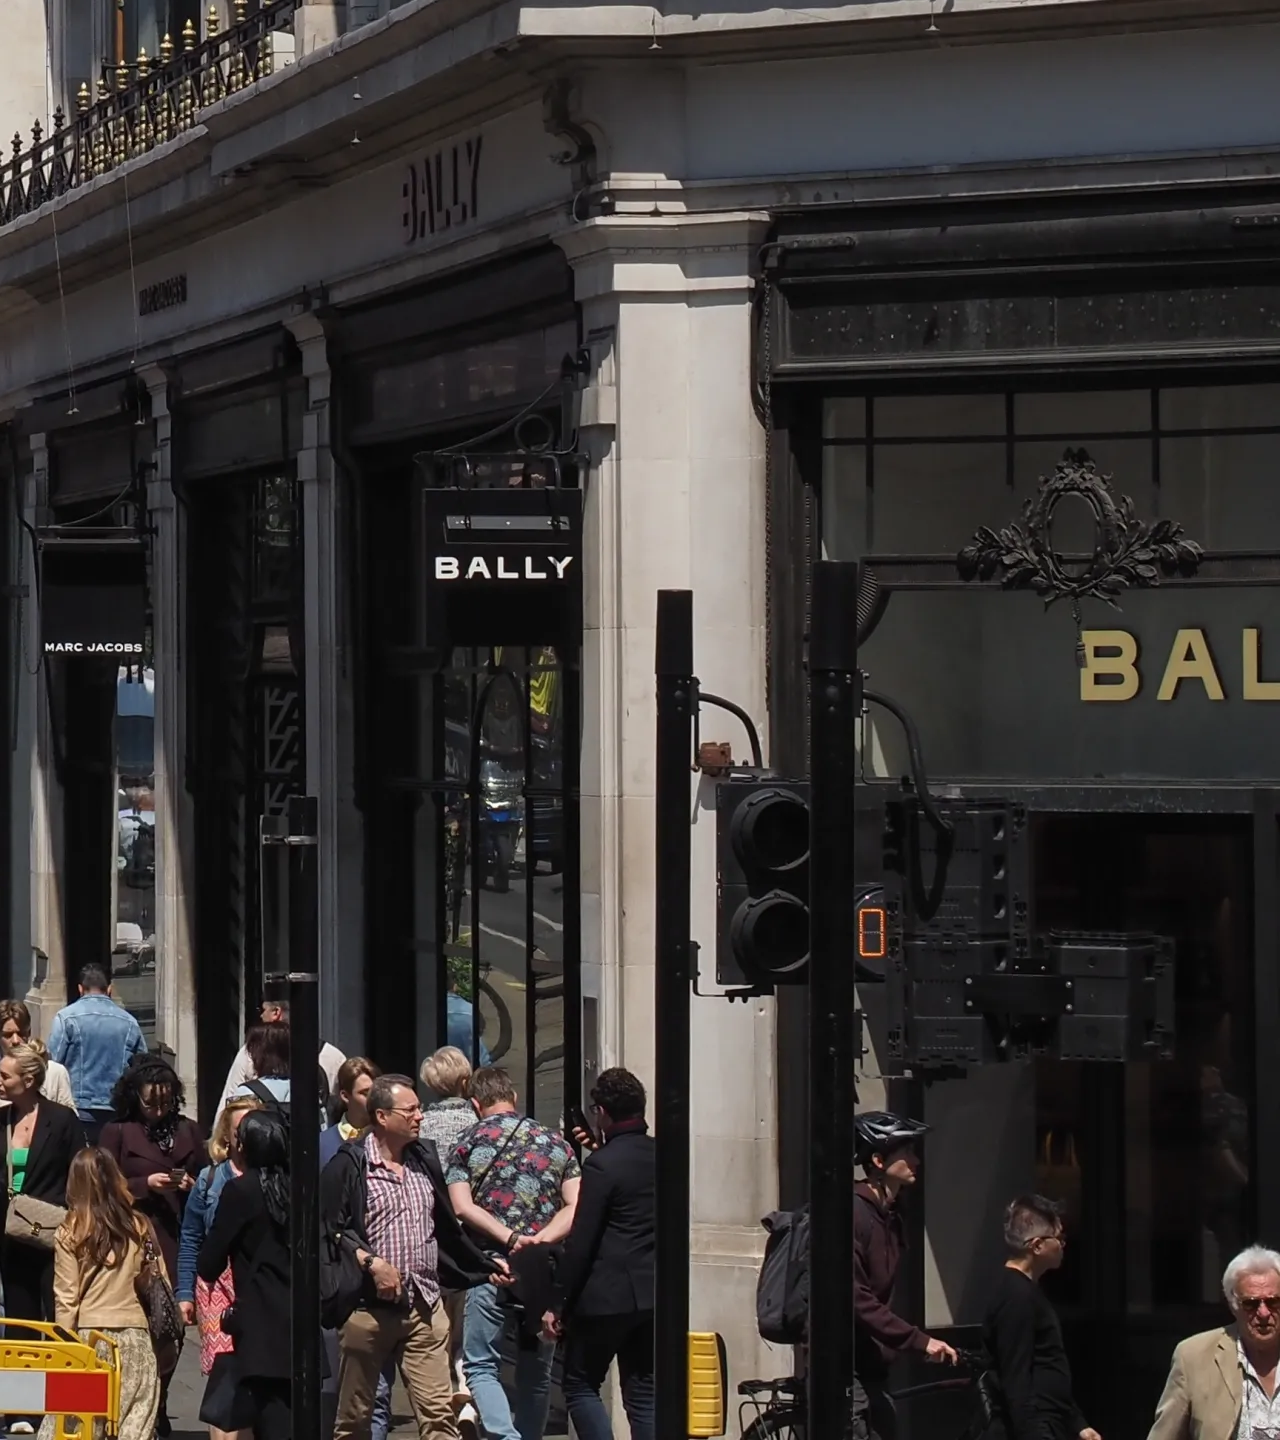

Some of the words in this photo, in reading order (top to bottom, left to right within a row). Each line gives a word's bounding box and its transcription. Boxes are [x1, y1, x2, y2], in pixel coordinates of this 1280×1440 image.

[402, 134, 483, 244] BALLY
[435, 556, 573, 579] BALLY
[45, 643, 83, 652] MARC
[87, 643, 143, 652] JACOBS
